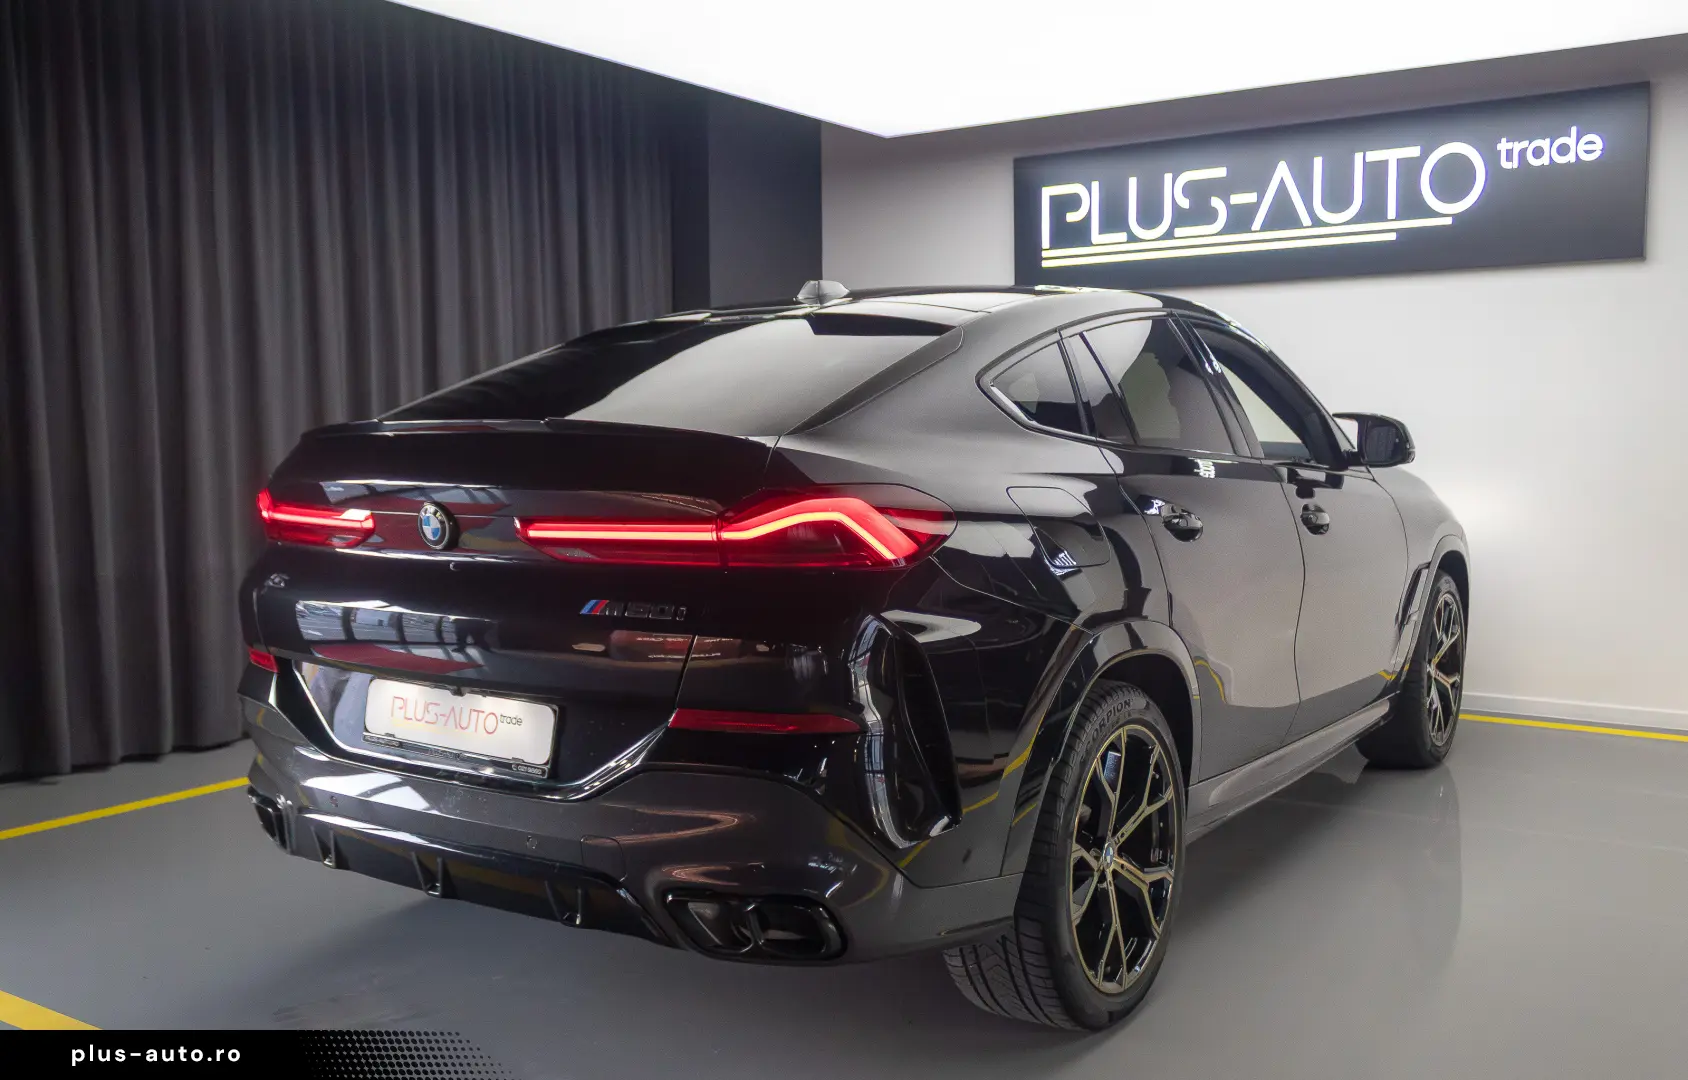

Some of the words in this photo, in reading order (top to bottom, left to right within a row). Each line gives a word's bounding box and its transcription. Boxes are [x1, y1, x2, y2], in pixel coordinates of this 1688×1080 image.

[1041, 141, 1487, 250] PLUS-AUTO
[1496, 125, 1604, 170] trade
[391, 696, 499, 735] PLUS-AUTO
[499, 714, 523, 726] trade
